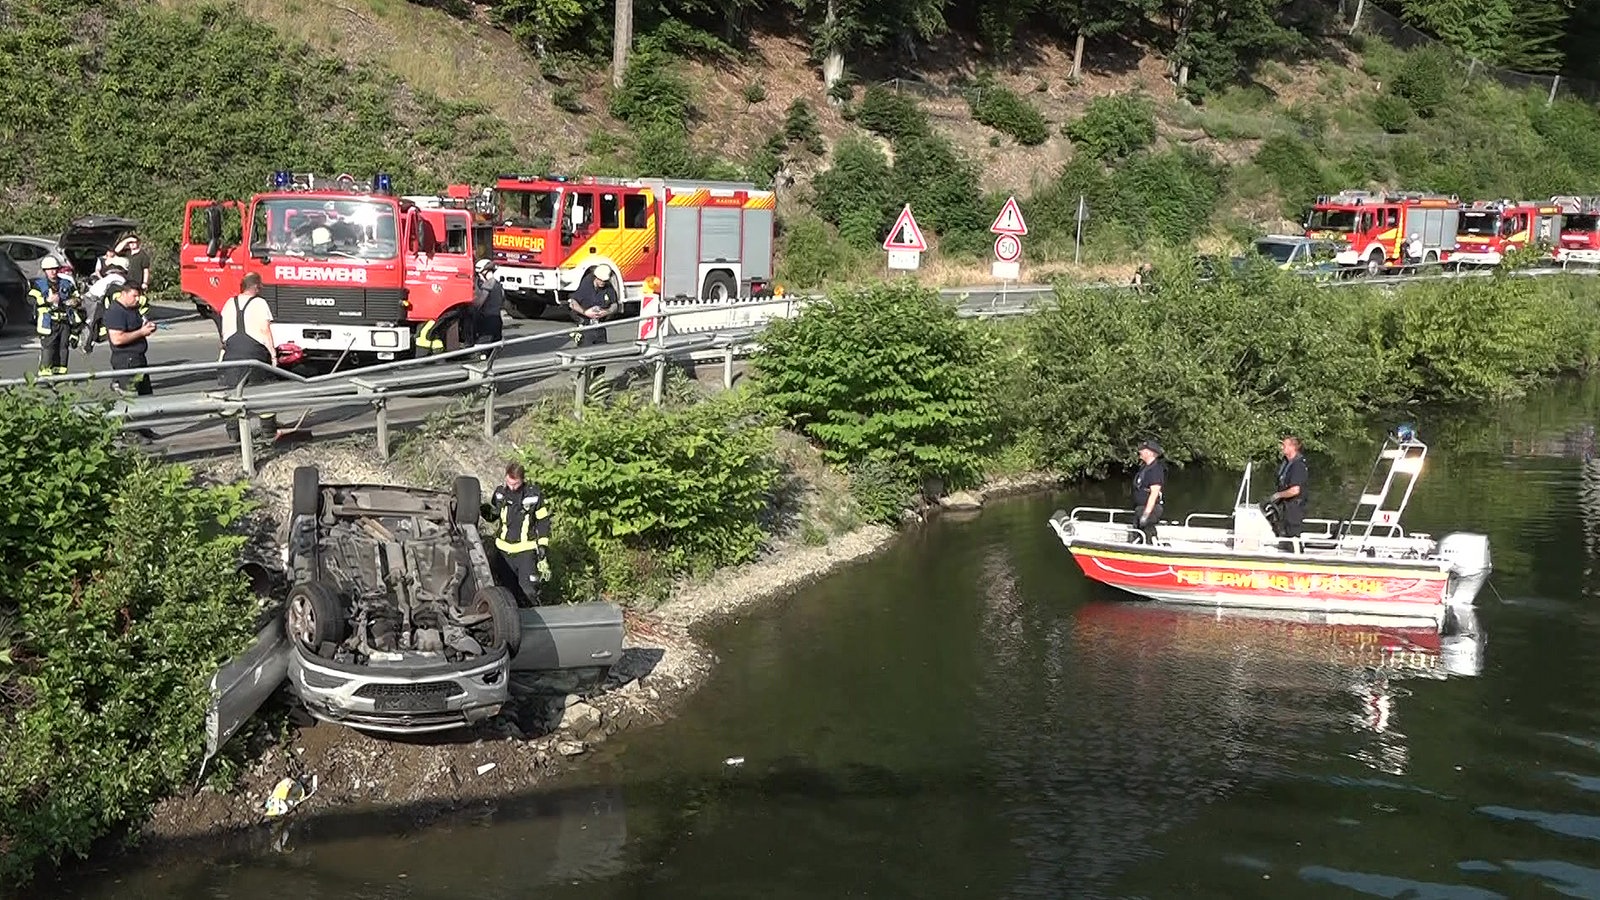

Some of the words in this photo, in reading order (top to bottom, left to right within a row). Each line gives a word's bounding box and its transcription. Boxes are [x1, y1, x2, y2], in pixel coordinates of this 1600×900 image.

[493, 234, 545, 249] EUERWEHR
[1001, 241, 1015, 254] 50
[274, 265, 367, 283] FEUERWEHR
[306, 297, 335, 306] IVECO
[1176, 569, 1289, 590] FEUERWEHR
